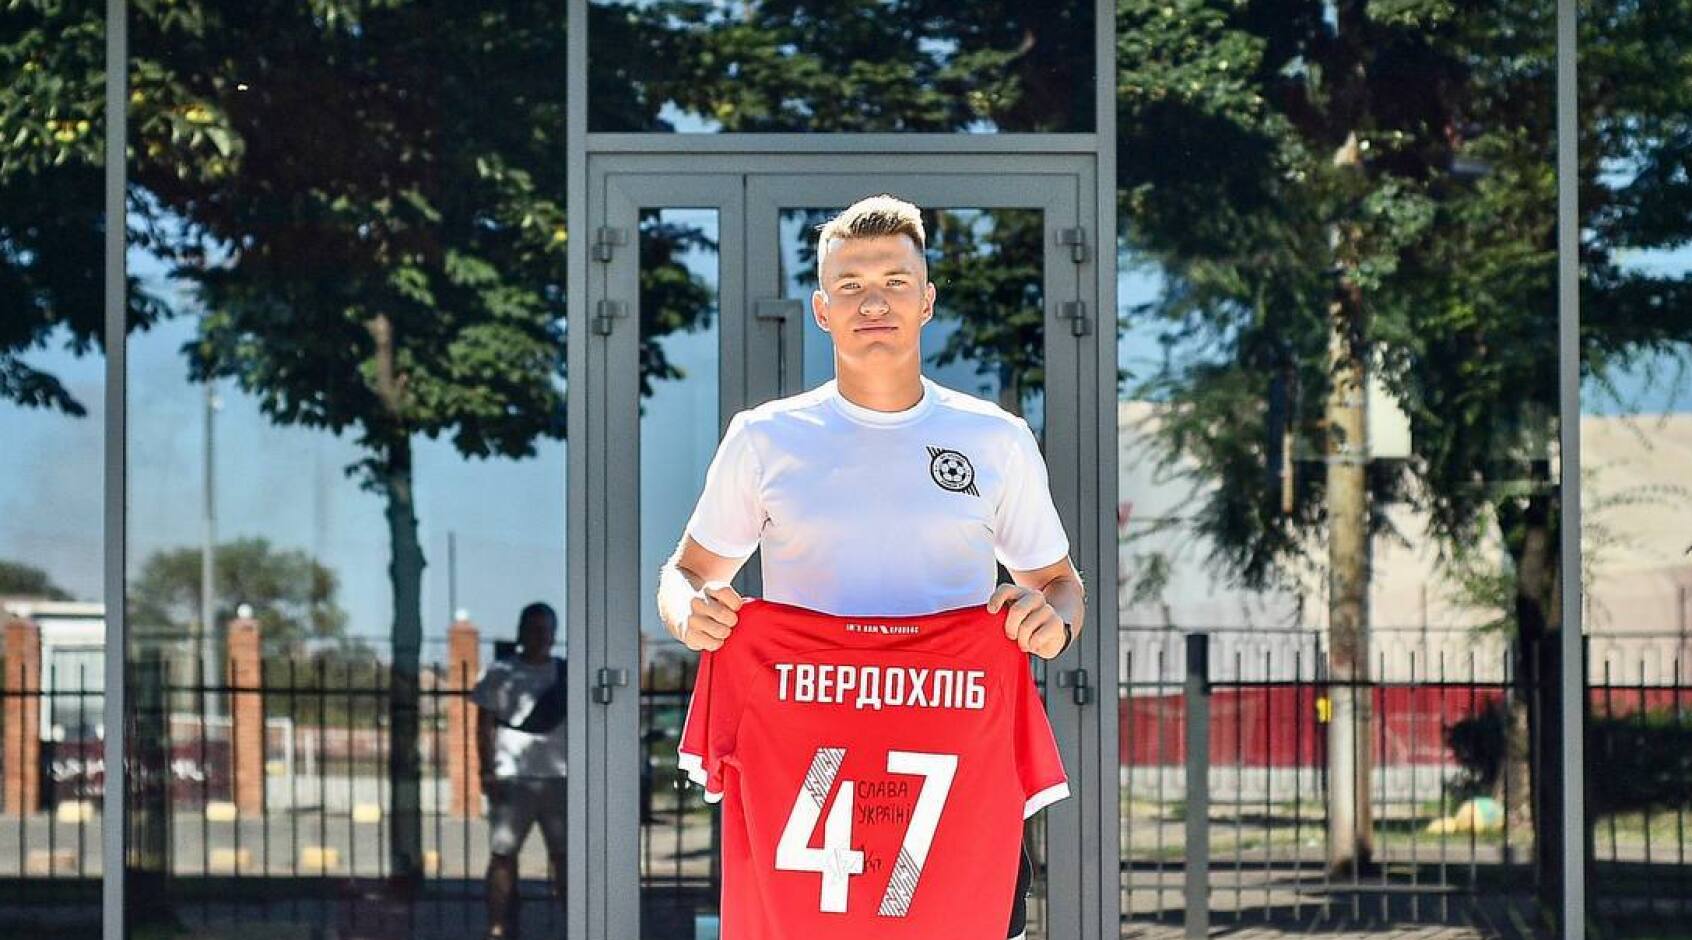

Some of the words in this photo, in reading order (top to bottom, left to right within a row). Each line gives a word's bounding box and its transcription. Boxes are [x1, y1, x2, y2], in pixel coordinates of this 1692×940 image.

[774, 663, 986, 711] ТВЕРДОХЛІБ
[858, 780, 908, 799] СЛАВА
[775, 746, 960, 918] 47
